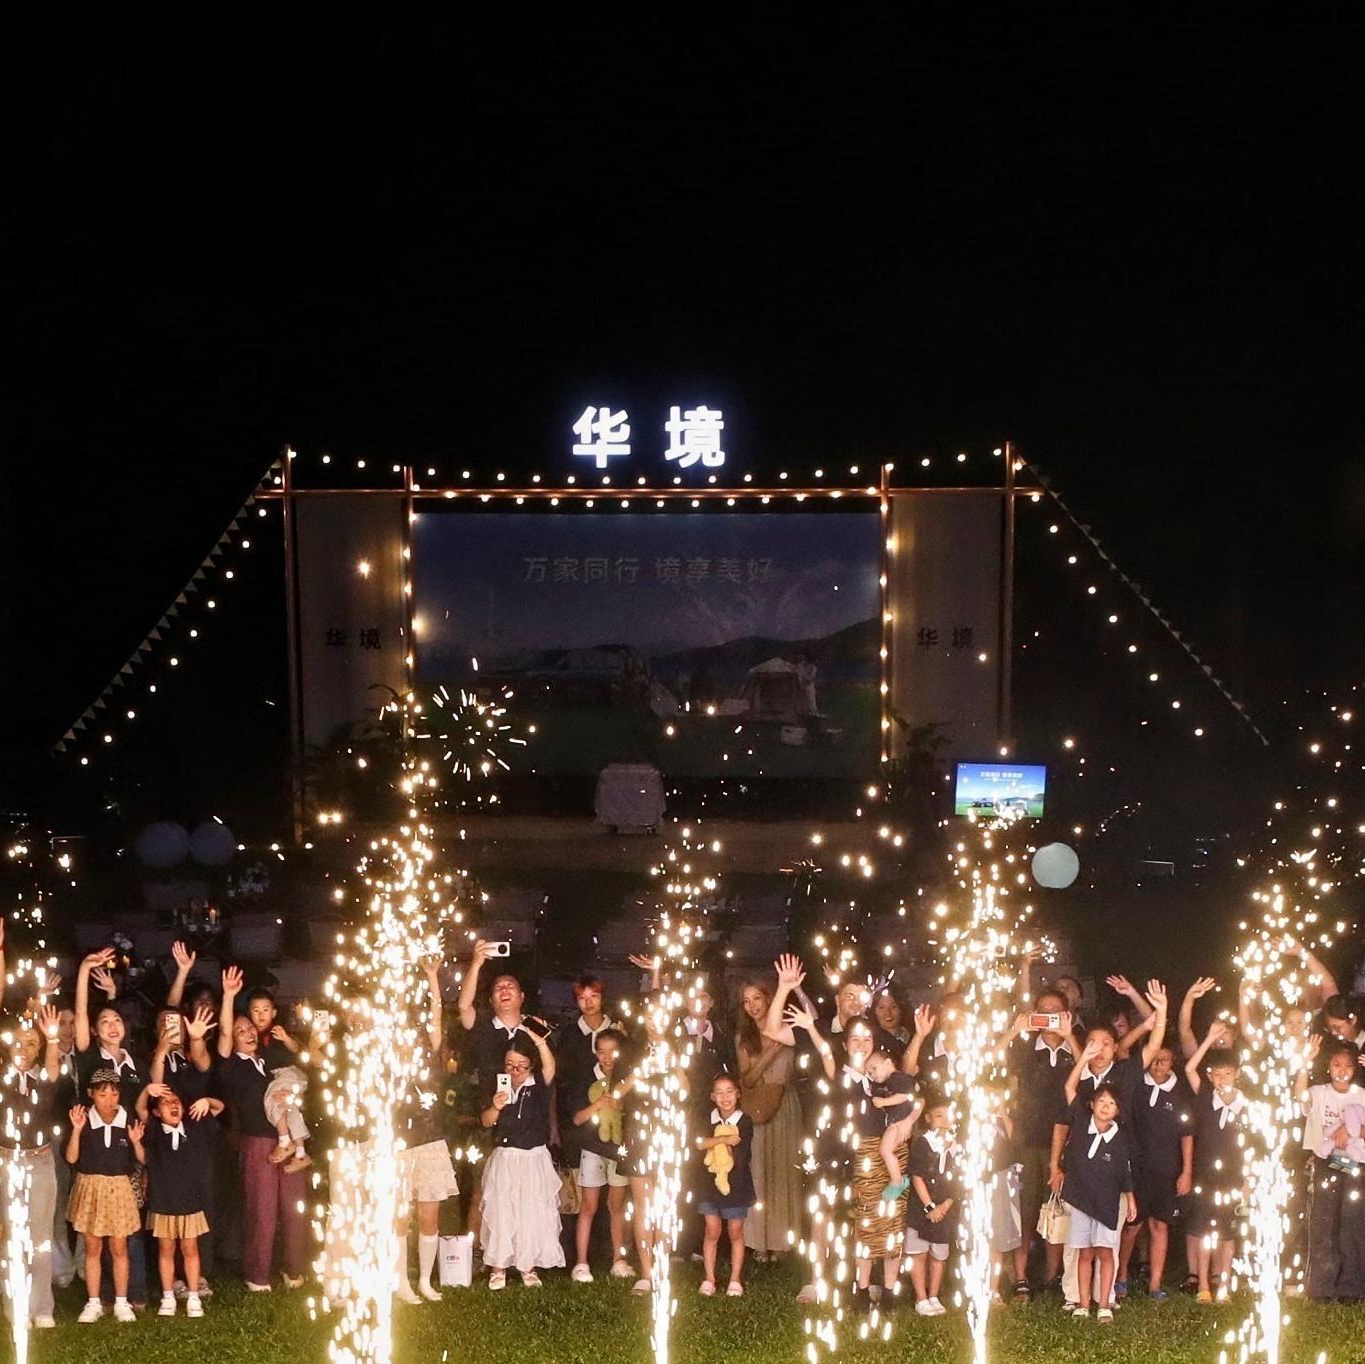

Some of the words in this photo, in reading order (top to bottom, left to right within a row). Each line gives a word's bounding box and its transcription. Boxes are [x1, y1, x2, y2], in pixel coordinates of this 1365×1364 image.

[572, 405, 725, 468] 华境
[523, 556, 640, 585] 万家同行
